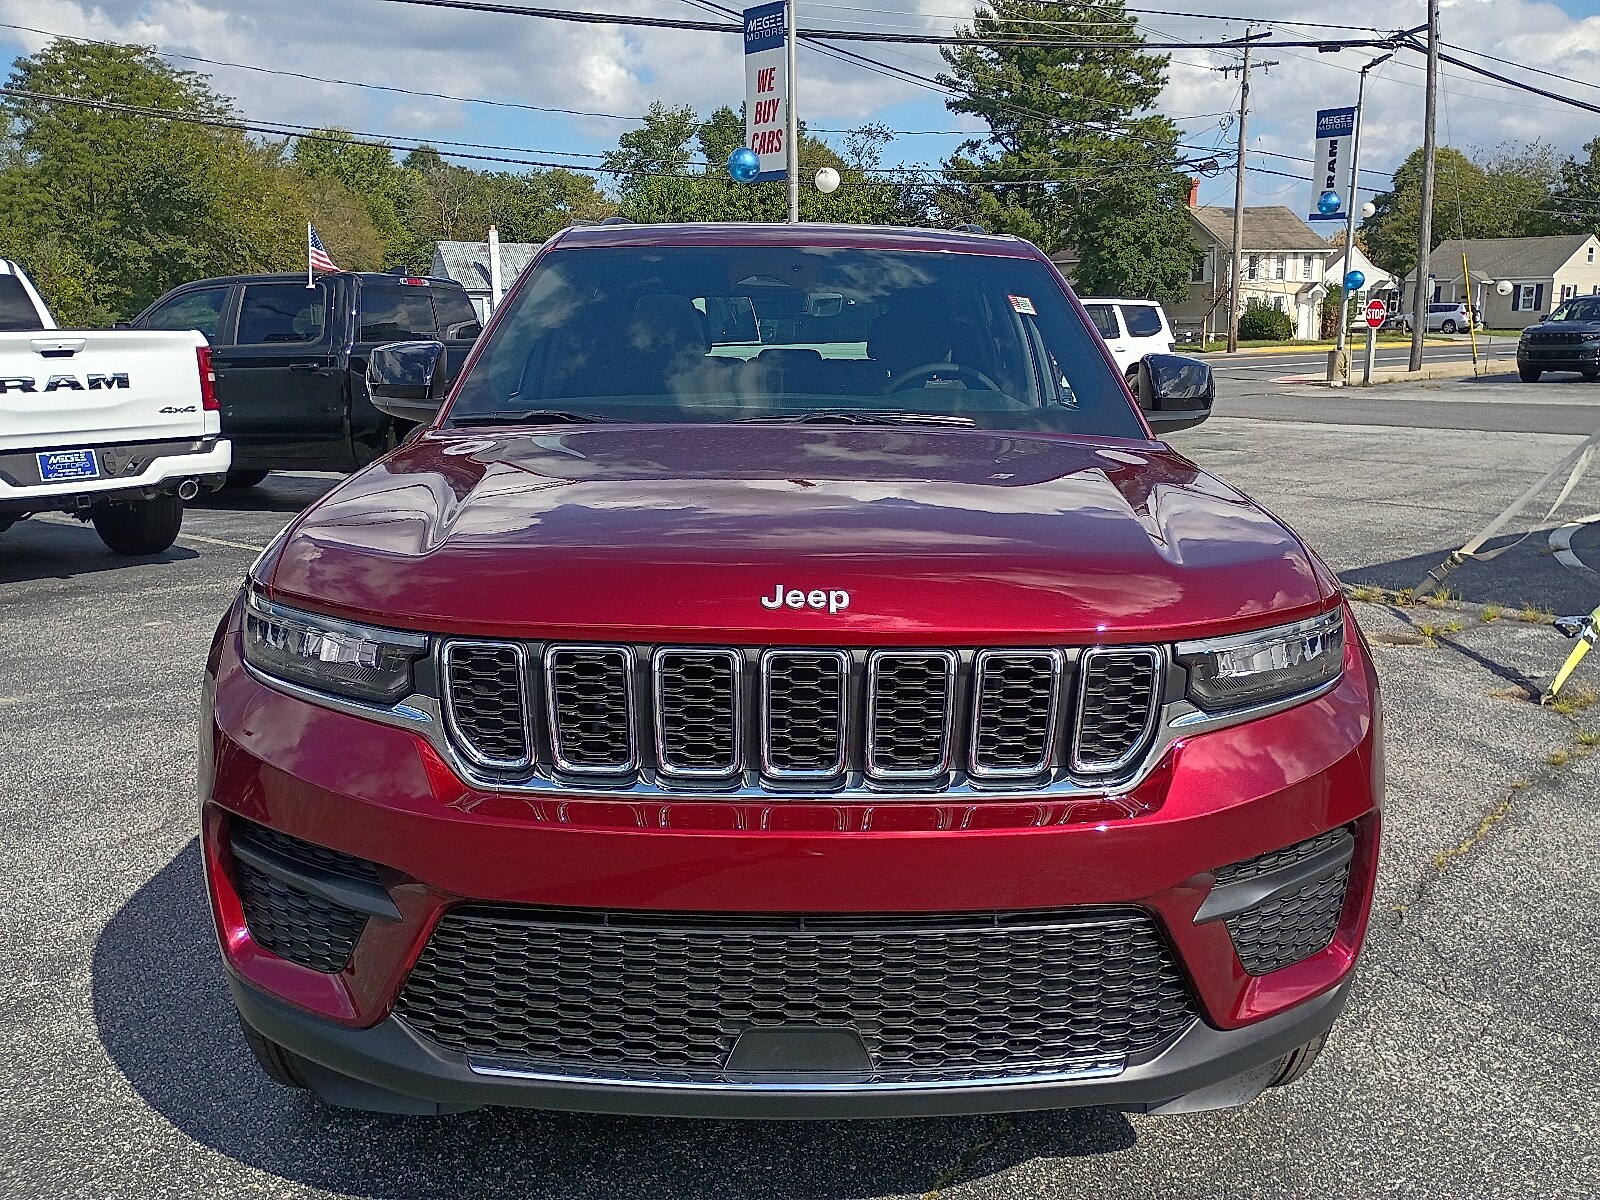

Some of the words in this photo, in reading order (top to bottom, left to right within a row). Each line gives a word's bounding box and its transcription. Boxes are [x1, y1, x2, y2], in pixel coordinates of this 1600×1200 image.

[746, 12, 783, 33] MEGEE
[746, 26, 784, 42] MOTORS
[757, 67, 777, 94] WE
[754, 98, 781, 125] BUY
[1319, 114, 1353, 126] MEGEE
[1318, 122, 1353, 131] MOTORS
[751, 129, 783, 155] CARS
[1326, 139, 1339, 188] RAM
[1366, 308, 1385, 320] STOP
[0, 372, 130, 393] RAM
[760, 584, 850, 615] Jeep
